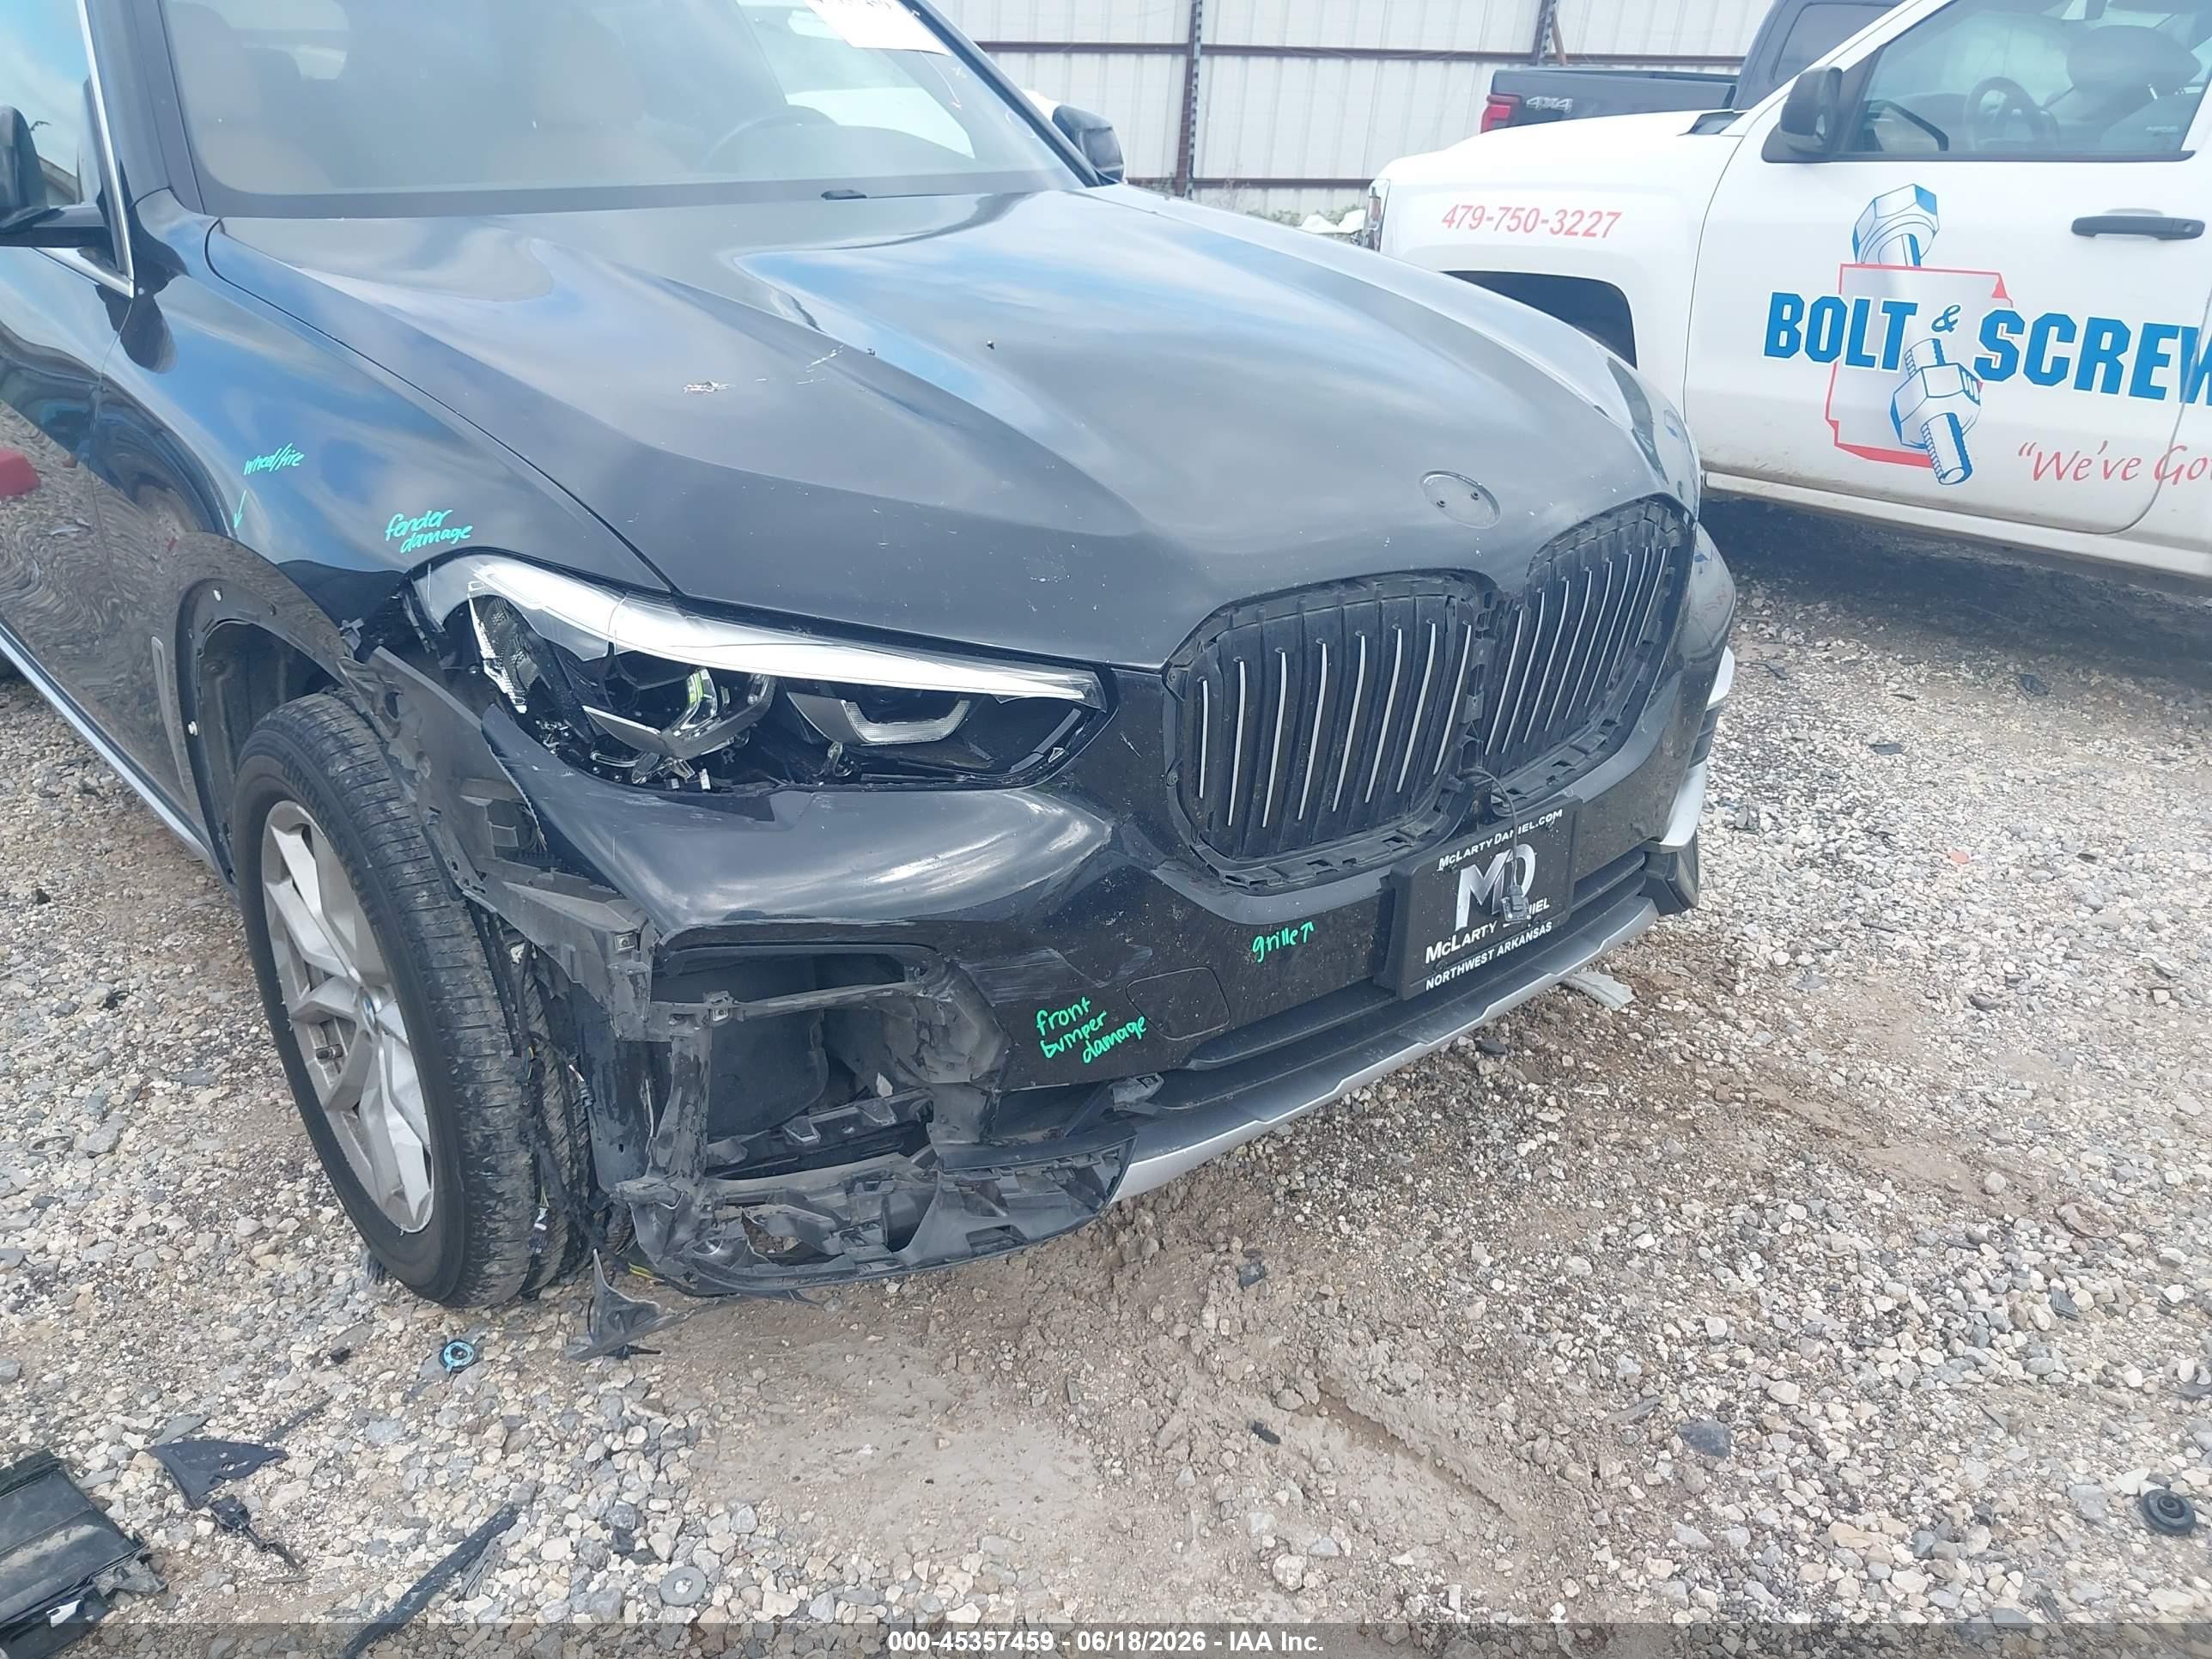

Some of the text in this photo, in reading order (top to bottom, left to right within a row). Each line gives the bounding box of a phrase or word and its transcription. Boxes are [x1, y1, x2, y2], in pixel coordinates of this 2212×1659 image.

[1442, 204, 1621, 238] 479-750-3227
[1763, 291, 1918, 370] BOLT
[1931, 304, 1961, 333] &
[2154, 445, 2212, 485] Go
[386, 509, 453, 541] fender
[400, 526, 473, 553] damage
[1251, 927, 1298, 963] grille
[1425, 921, 1553, 991] NORTHWEST ARKANSAS
[1036, 997, 1091, 1036] front
[1083, 1016, 1148, 1064] damage
